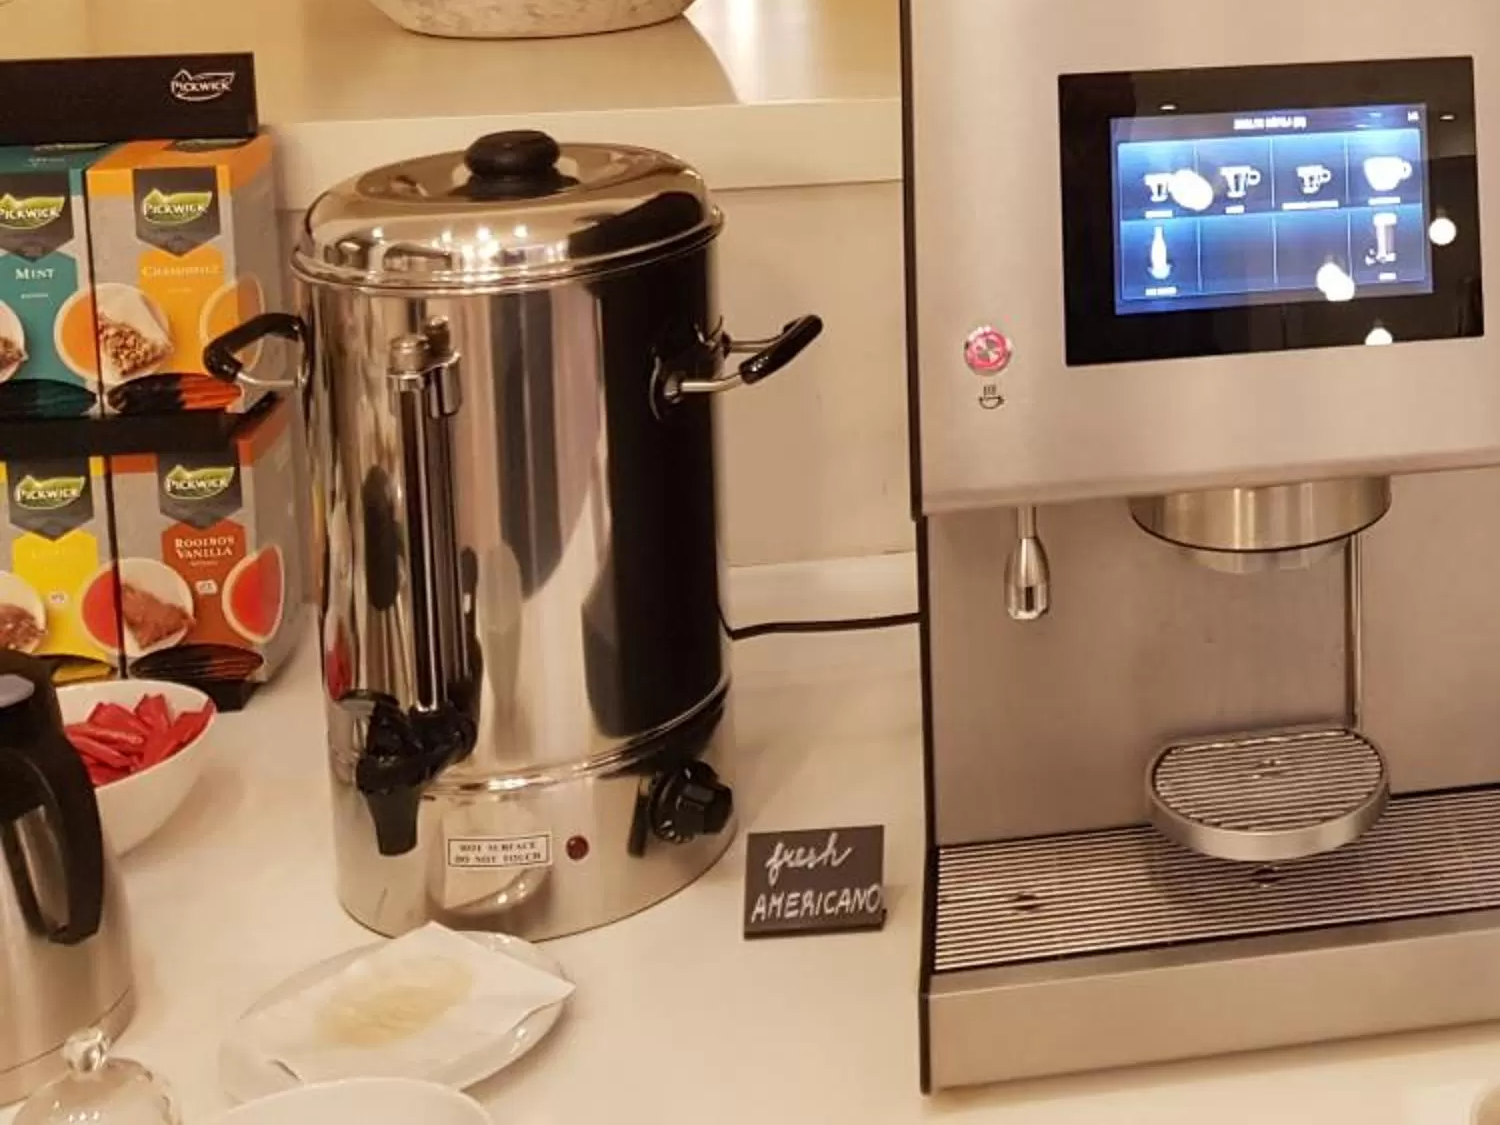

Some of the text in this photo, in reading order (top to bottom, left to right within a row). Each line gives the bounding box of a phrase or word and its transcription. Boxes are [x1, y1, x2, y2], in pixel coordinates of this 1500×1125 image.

[15, 267, 55, 280] MINT
[174, 535, 235, 549] ROOIBOS
[175, 546, 233, 559] VANILLA
[764, 832, 853, 887] fresh
[750, 882, 881, 924] AMERICANO
